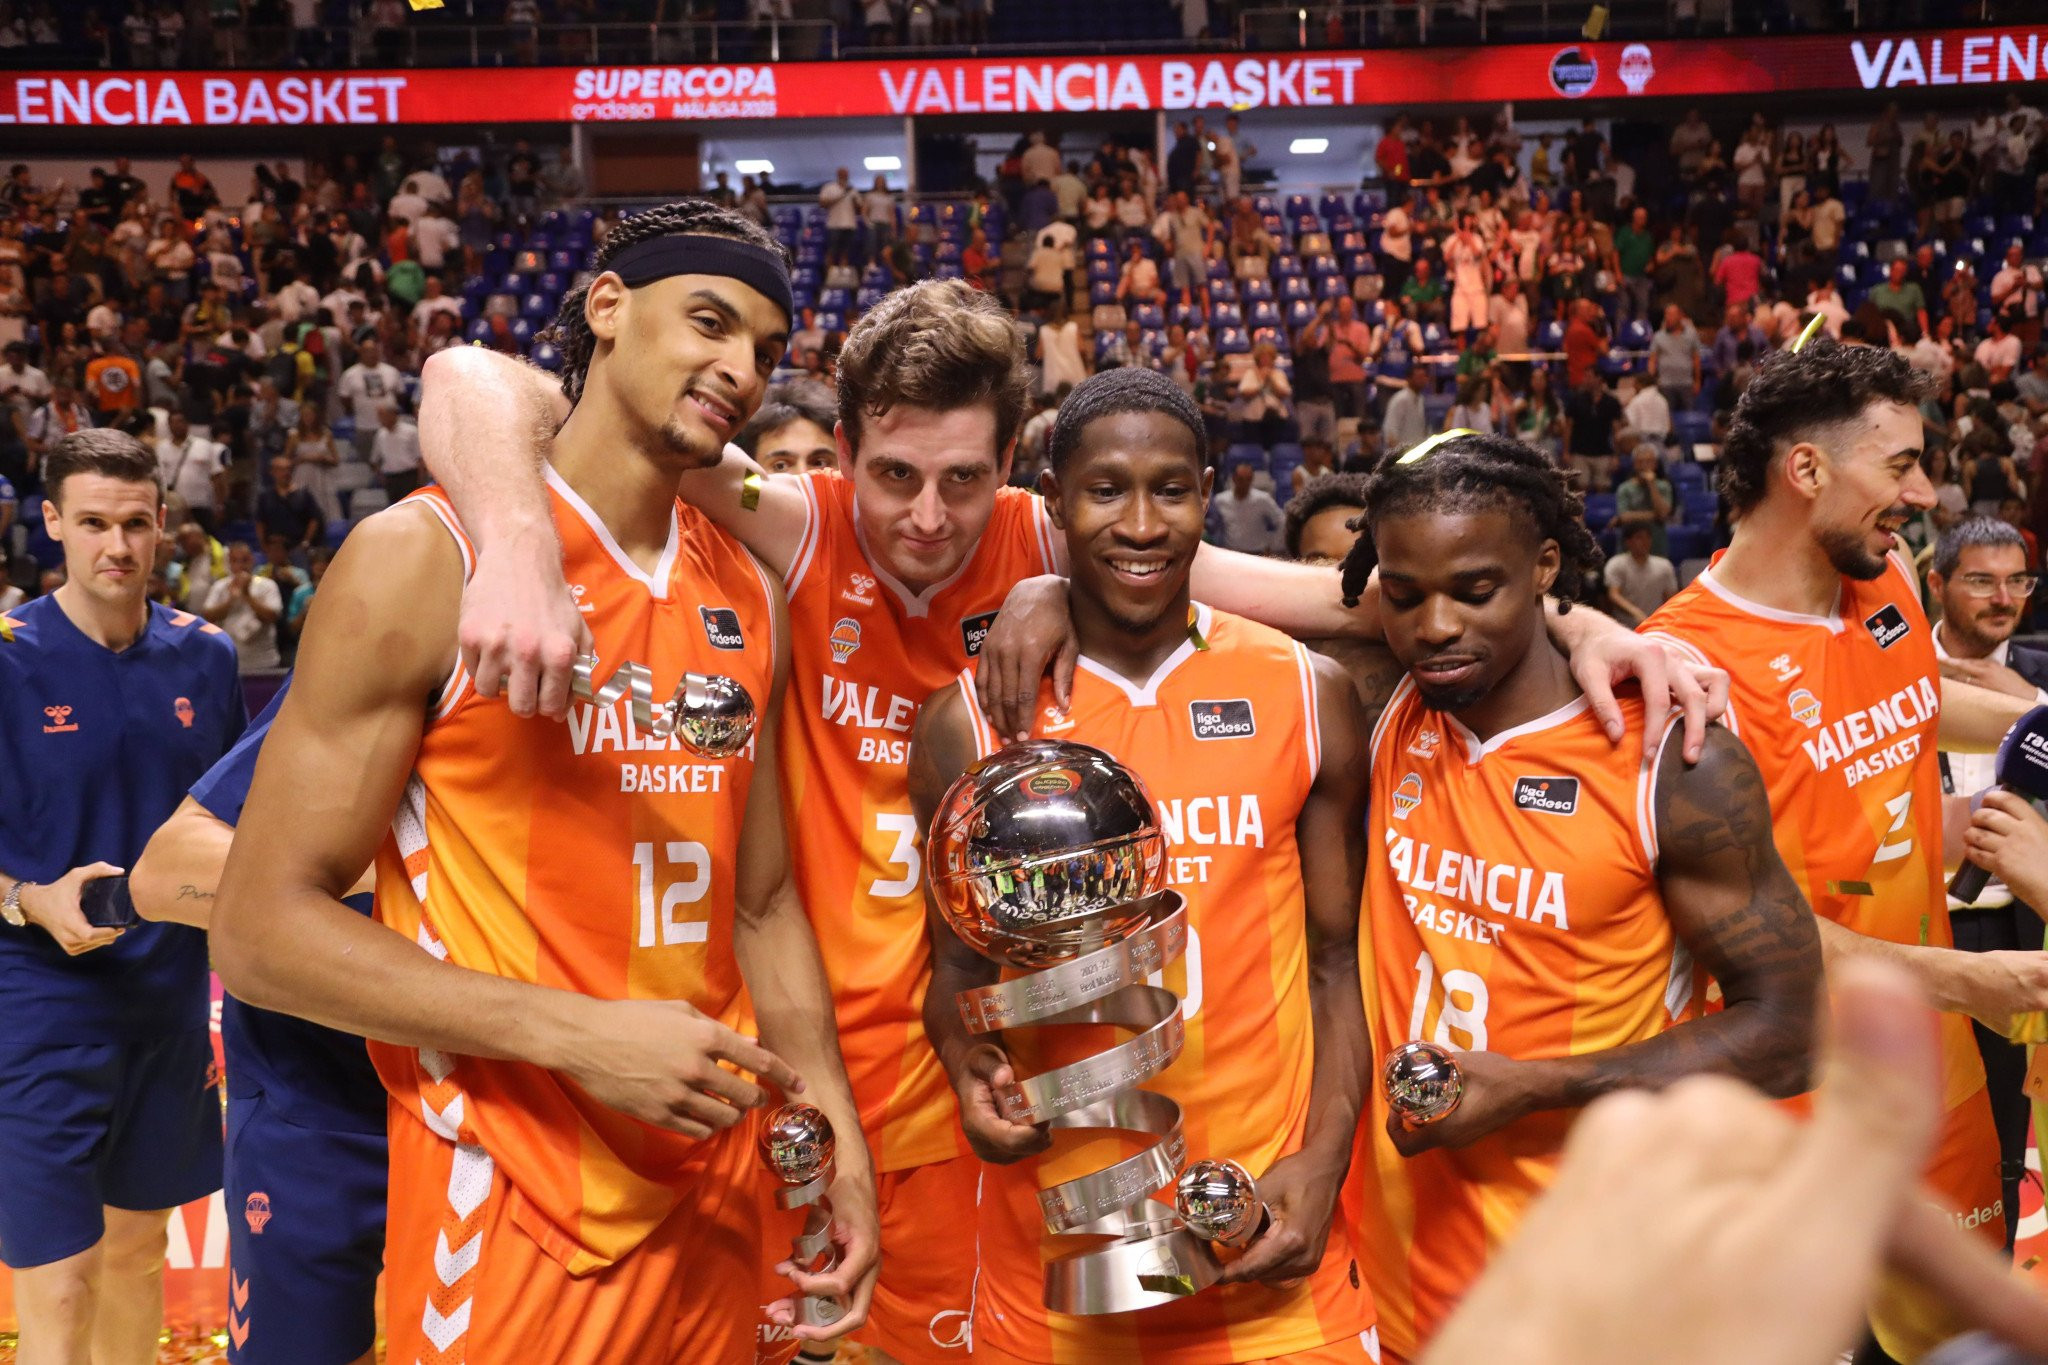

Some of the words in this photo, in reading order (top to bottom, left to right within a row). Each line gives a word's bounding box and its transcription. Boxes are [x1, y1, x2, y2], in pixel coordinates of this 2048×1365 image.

[1850, 35, 2048, 89] VALEN
[573, 66, 776, 99] SUPERCOPA
[879, 62, 1149, 114] VALENCIA
[1161, 58, 1364, 109] BASKET
[202, 76, 407, 124] BASKET
[571, 101, 655, 120] endesa
[842, 589, 874, 606] hummel
[967, 628, 989, 642] liga
[822, 673, 922, 733] VALE
[1197, 712, 1221, 726] liga
[1199, 723, 1252, 735] endesa
[857, 738, 911, 764] BAS
[1843, 733, 1921, 788] BASKET
[620, 763, 724, 793] BASKET
[1521, 784, 1546, 797] liga
[1519, 794, 1572, 811] endesa
[1157, 795, 1264, 848] NCIA
[868, 813, 921, 897] 3
[632, 842, 711, 947] 12
[1409, 951, 1489, 1052] 18
[1956, 1200, 2004, 1231] idea
